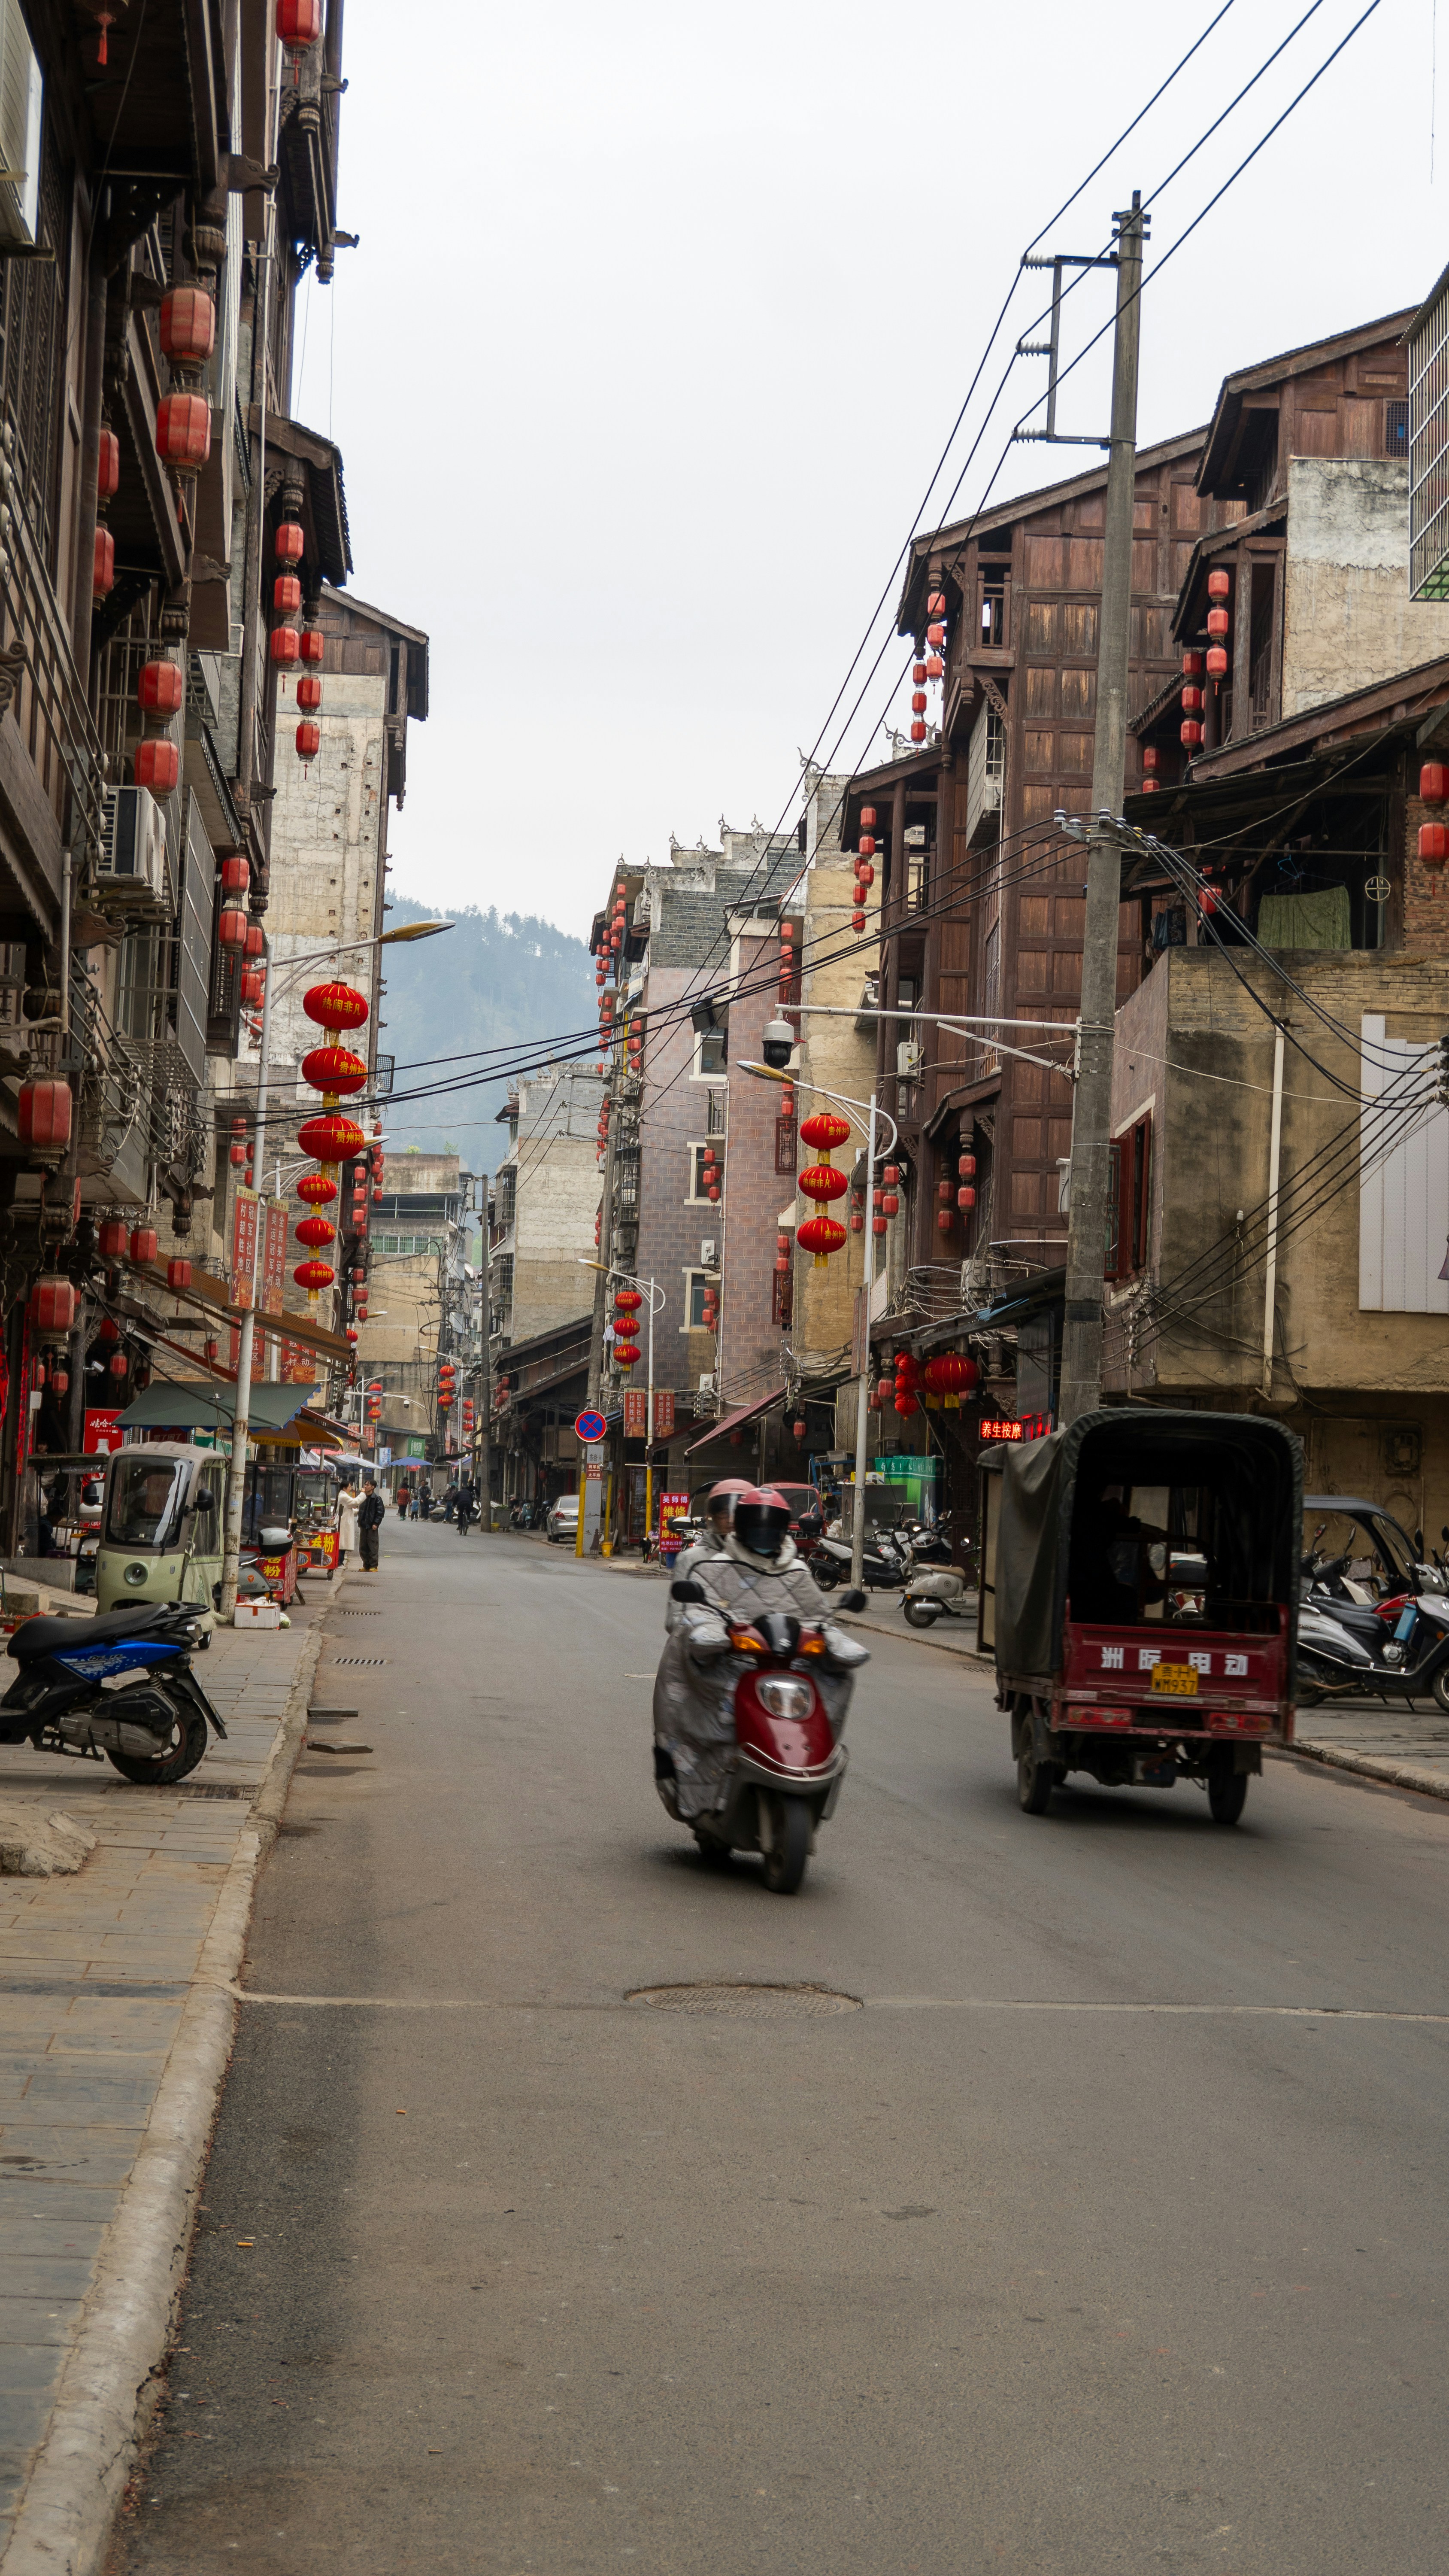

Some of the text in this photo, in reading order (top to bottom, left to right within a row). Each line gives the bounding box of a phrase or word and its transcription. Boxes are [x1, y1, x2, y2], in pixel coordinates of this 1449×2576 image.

[322, 996, 361, 1016] 热闹非凡
[303, 1183, 327, 1192] 热闹非凡
[803, 1177, 831, 1189] 热闹非凡
[238, 1203, 246, 1271] 村超胜地
[245, 1206, 254, 1273] 冠军社区
[266, 1212, 277, 1286] 奥运冠军村
[275, 1215, 284, 1288] 全民来运动
[309, 1270, 332, 1279] 贵州村超
[982, 1421, 1022, 1440] 养生按摩
[663, 1506, 686, 1517] 维修
